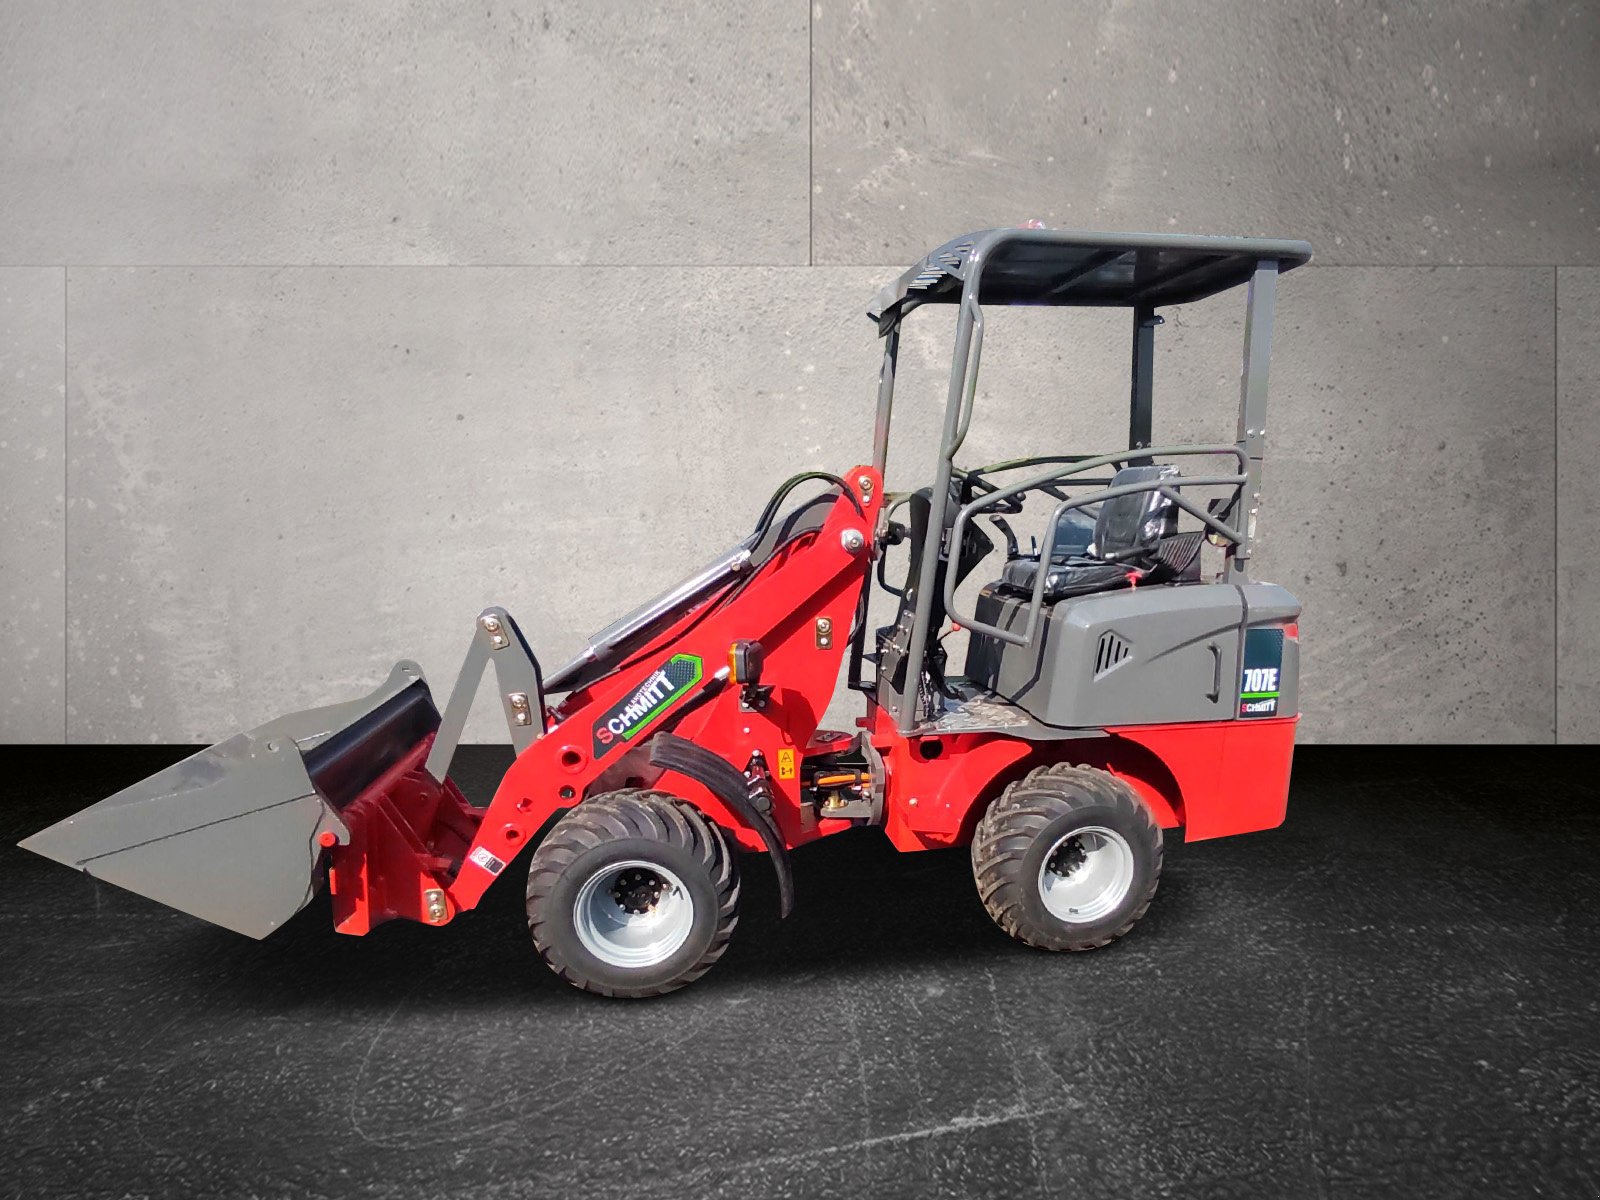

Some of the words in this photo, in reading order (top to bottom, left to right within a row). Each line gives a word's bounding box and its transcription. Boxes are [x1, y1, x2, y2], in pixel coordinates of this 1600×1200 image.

[1243, 668, 1278, 692] 707E
[596, 669, 675, 744] SCHMITT
[1241, 699, 1276, 712] SCHMITT
